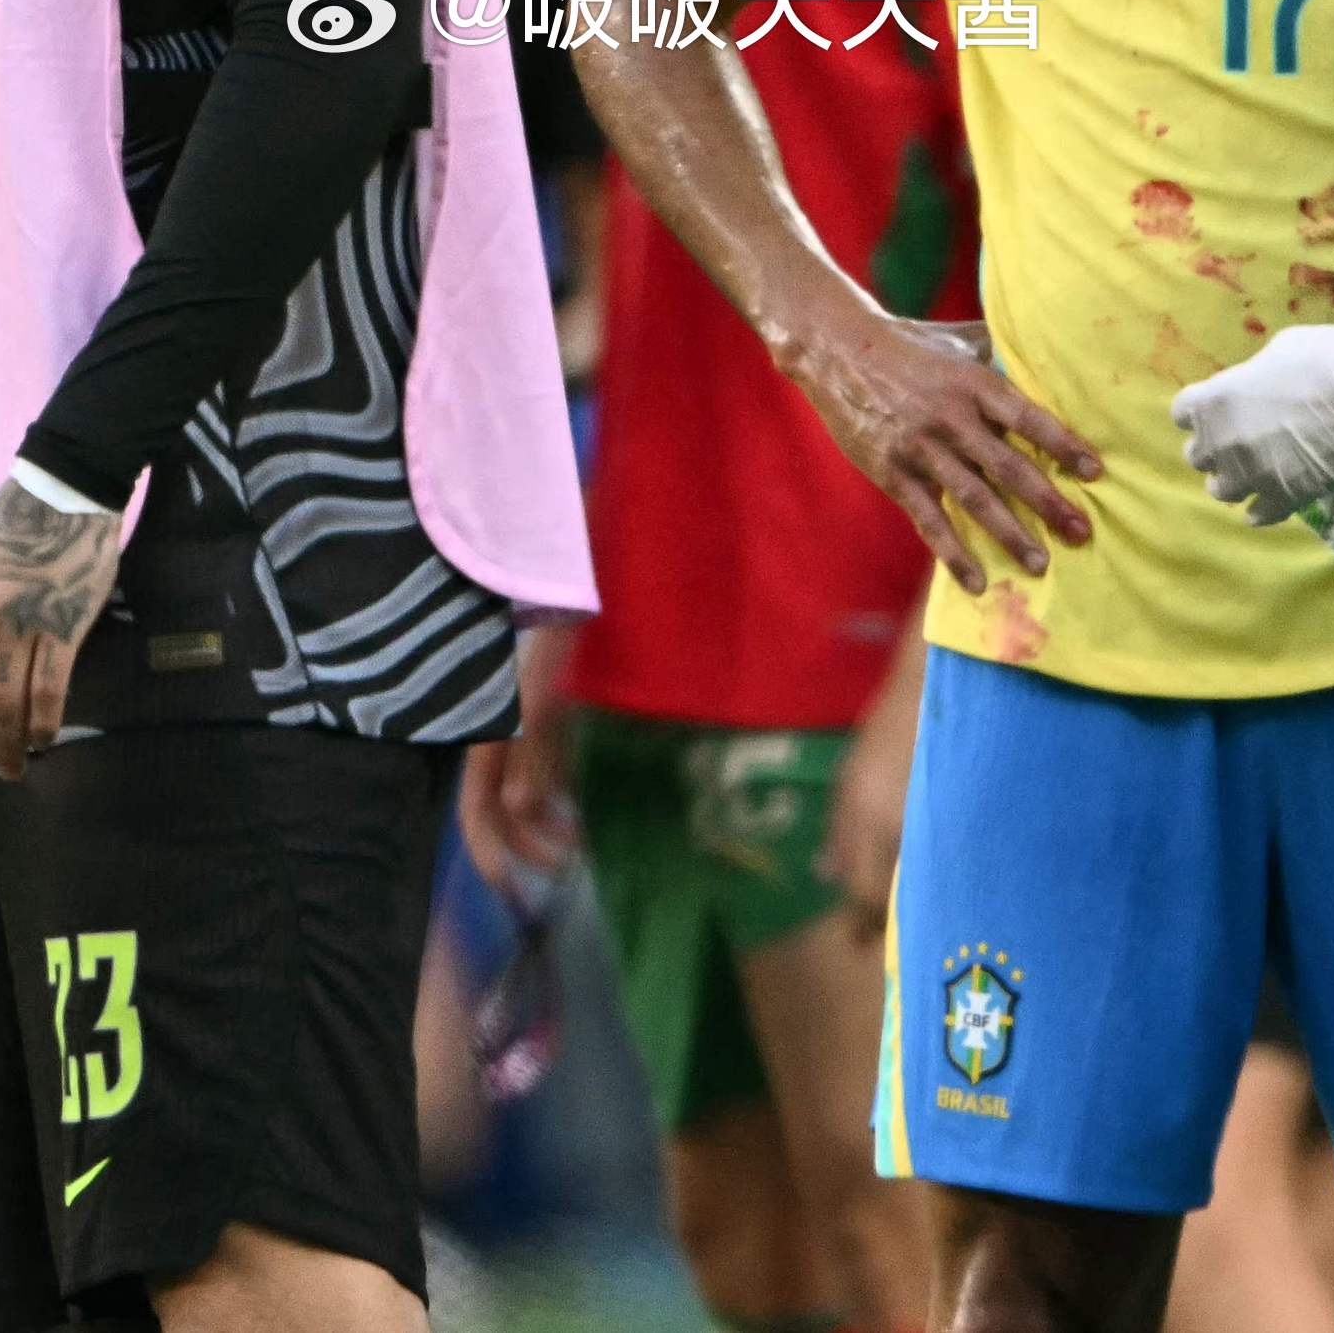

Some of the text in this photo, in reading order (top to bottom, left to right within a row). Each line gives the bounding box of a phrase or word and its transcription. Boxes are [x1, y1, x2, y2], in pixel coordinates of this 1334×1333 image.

[44, 930, 143, 1124] 23
[963, 1011, 992, 1028] CBF
[937, 1087, 1009, 1119] BRASIL
